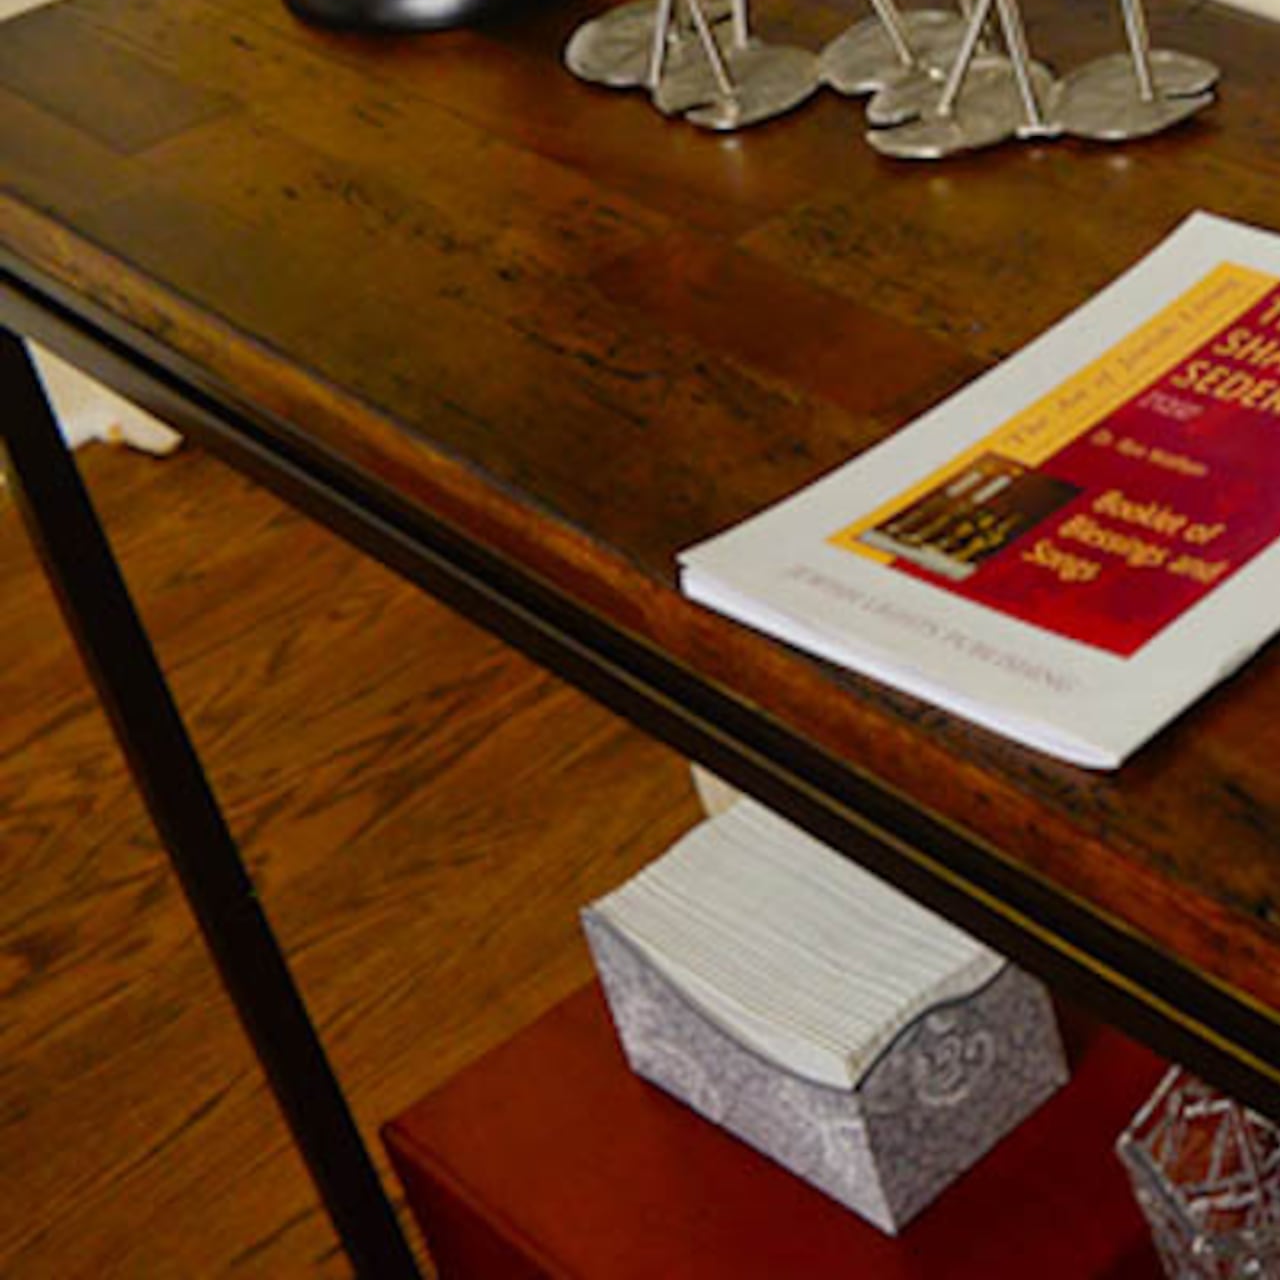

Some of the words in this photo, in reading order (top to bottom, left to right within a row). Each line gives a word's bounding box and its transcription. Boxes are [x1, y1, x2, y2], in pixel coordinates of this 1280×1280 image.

[1058, 514, 1170, 567] Blessings
[1092, 489, 1188, 537] Booklet
[1183, 522, 1228, 546] of
[1021, 539, 1102, 583] Songs
